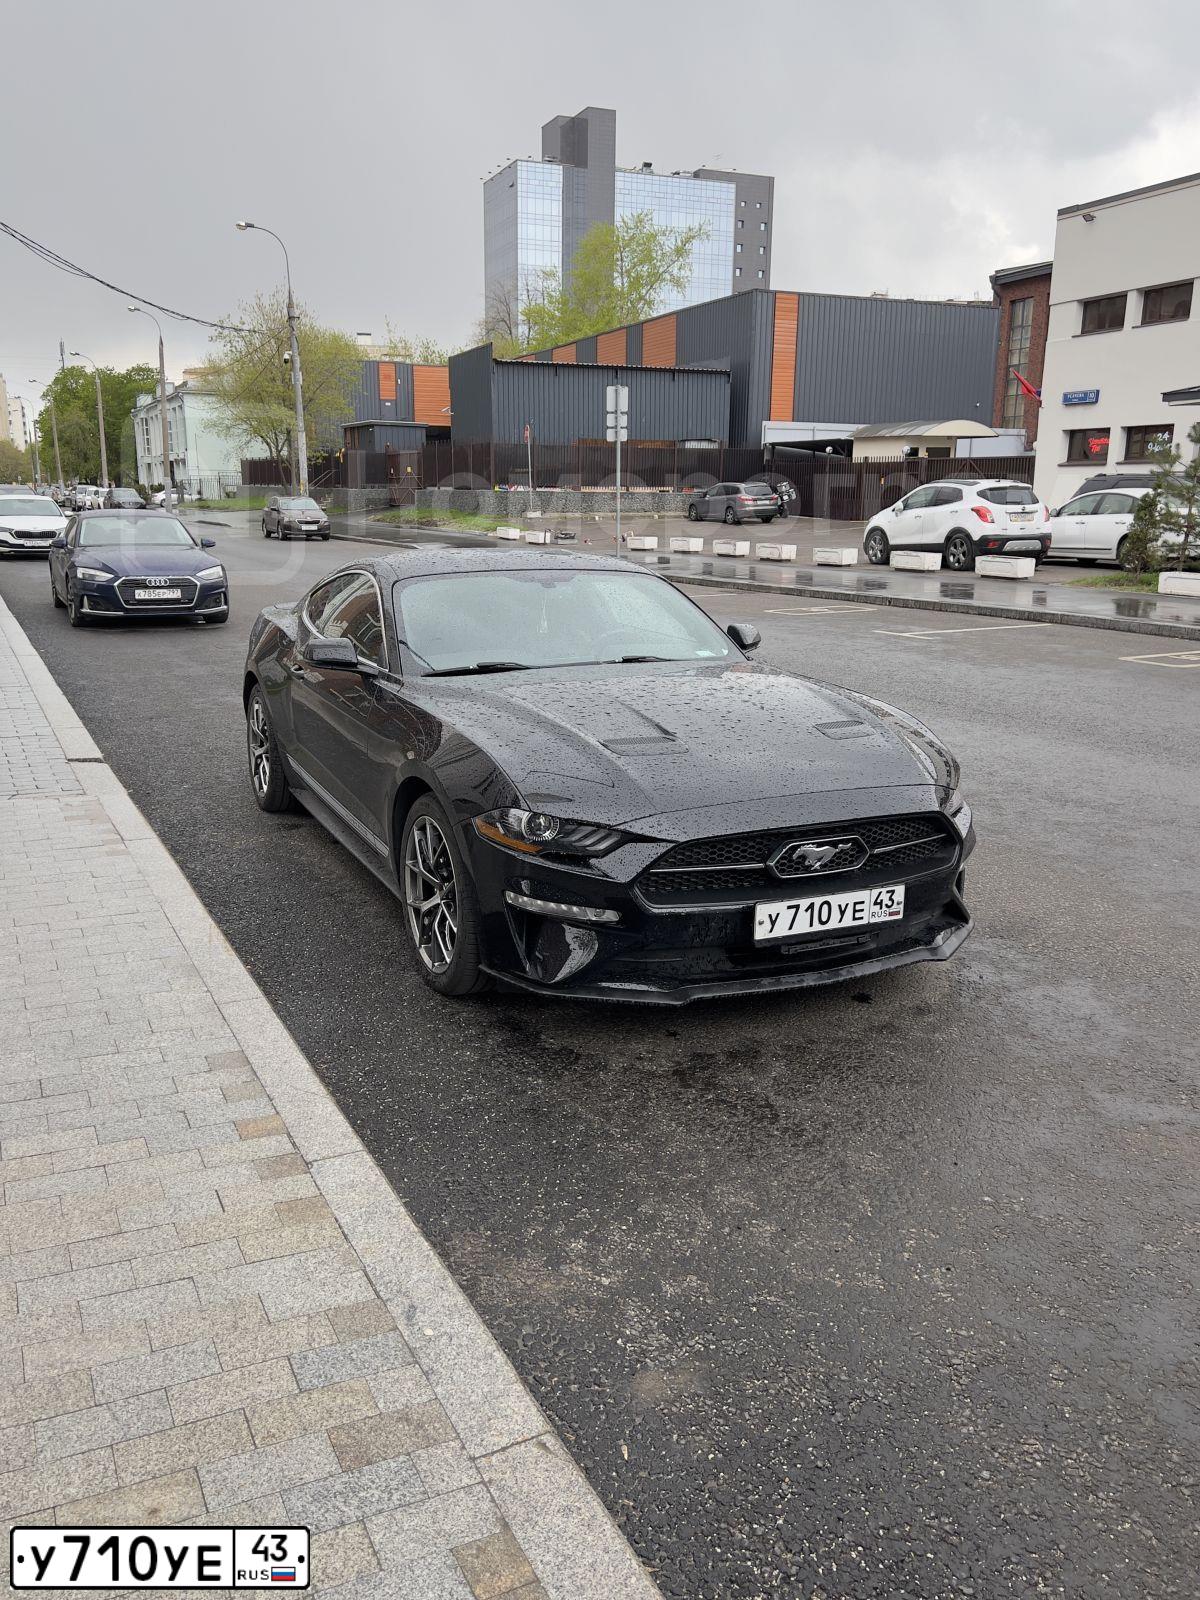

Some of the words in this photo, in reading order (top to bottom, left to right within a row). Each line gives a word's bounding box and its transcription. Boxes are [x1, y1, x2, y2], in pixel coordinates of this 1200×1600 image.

[768, 900, 865, 934] У710УЕ
[872, 889, 896, 910] 43
[871, 909, 888, 919] RUS
